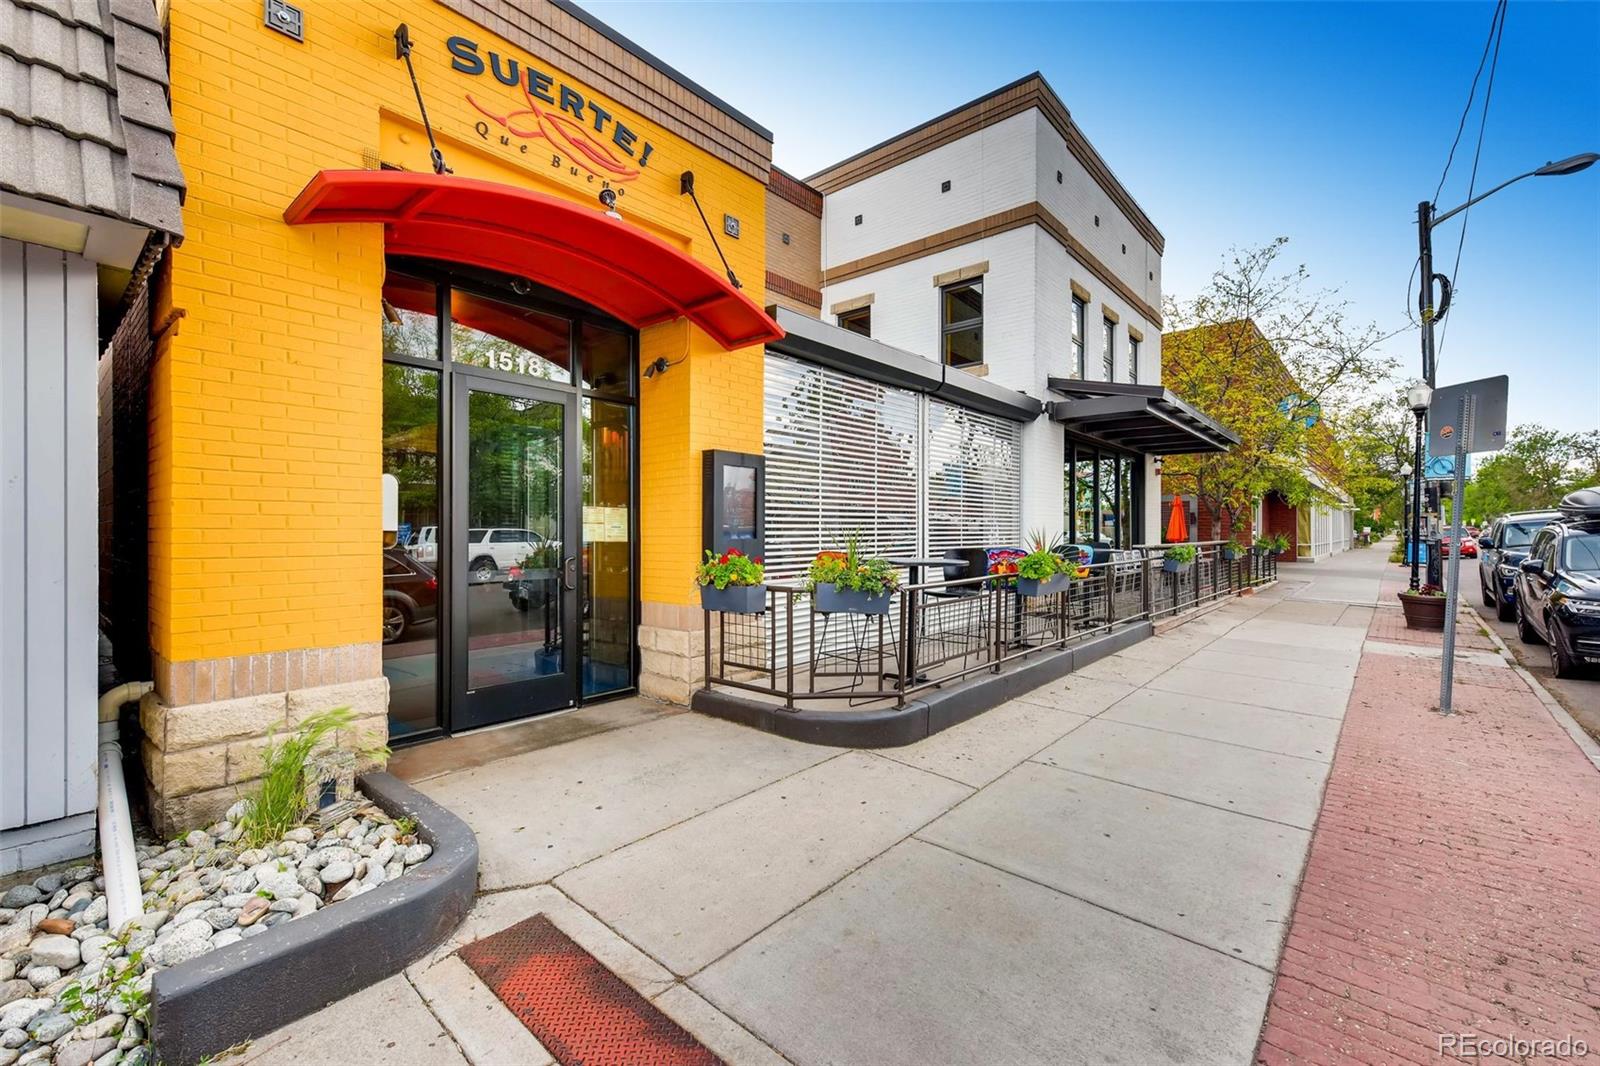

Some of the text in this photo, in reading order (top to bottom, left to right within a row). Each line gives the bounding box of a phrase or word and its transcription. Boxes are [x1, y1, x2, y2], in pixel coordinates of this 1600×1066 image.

[446, 35, 654, 167] SUERTE!
[475, 121, 625, 197] Que Bueno
[485, 349, 542, 377] 1518
